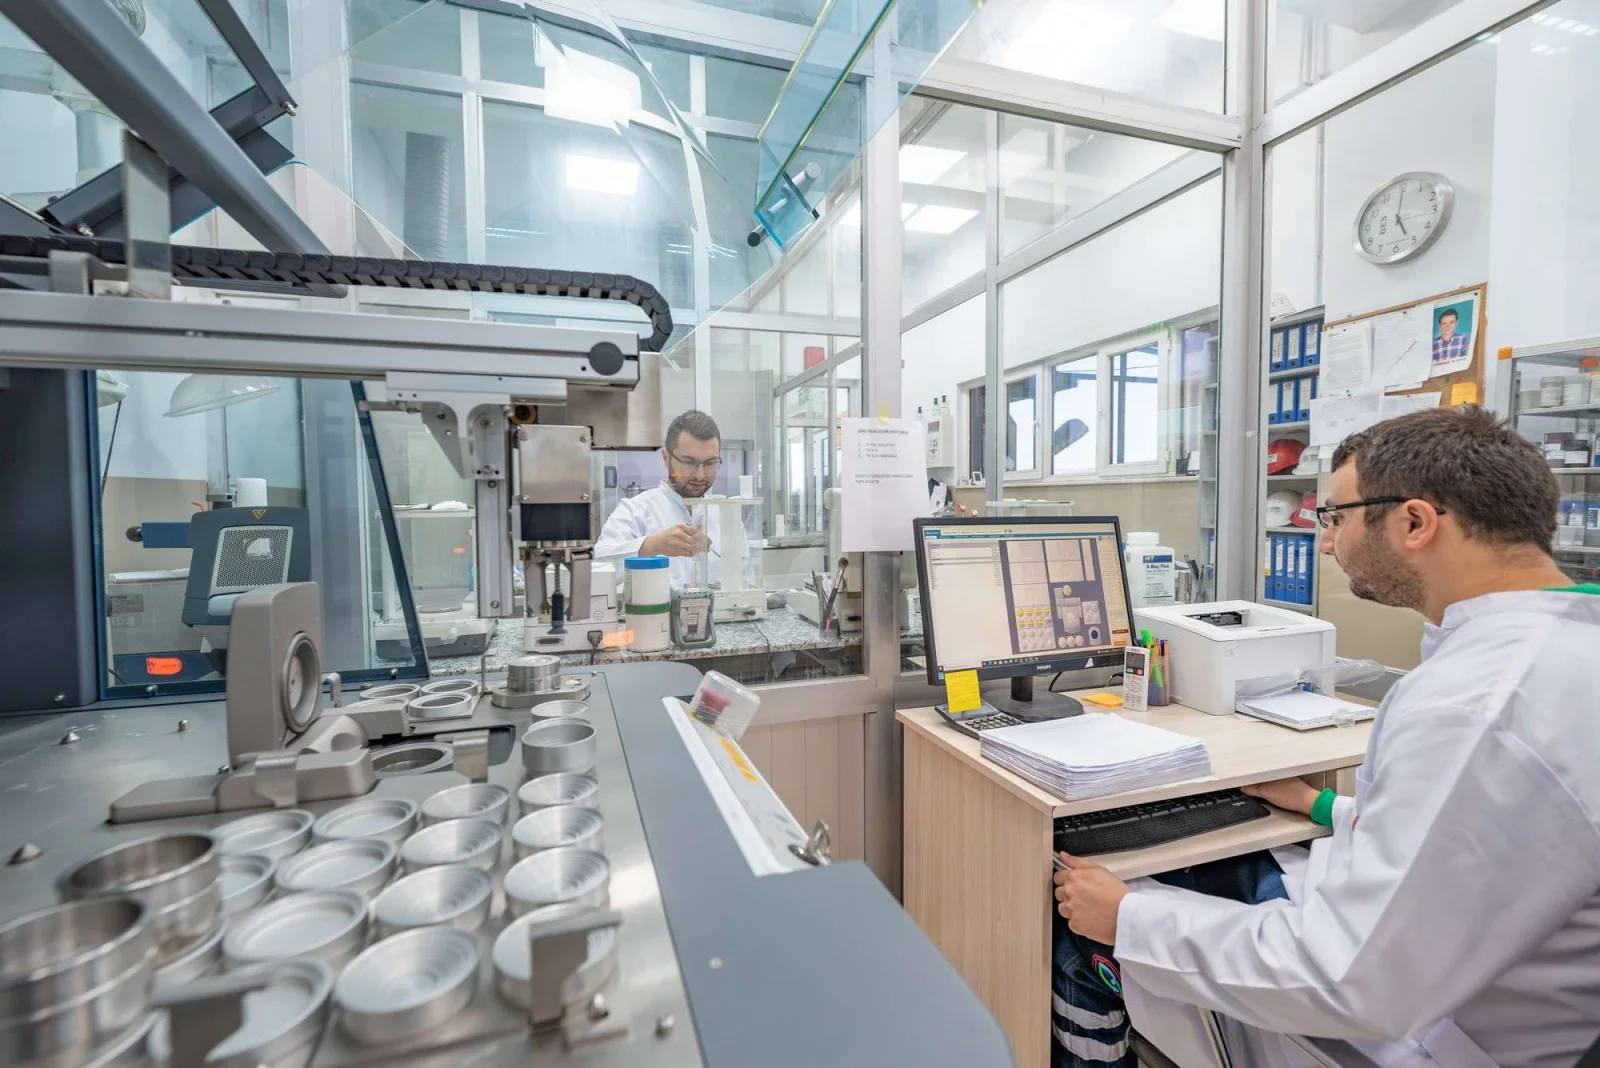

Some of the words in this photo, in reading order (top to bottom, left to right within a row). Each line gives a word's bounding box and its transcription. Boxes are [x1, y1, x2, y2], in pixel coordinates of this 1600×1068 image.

[1429, 191, 1436, 201] 2
[1370, 209, 1380, 219] 10
[1431, 205, 1438, 215] 3
[1364, 224, 1371, 234] 9
[1424, 221, 1431, 230] 4
[1367, 237, 1373, 247] 8
[1411, 236, 1417, 246] 5
[1378, 244, 1384, 254] 7
[1393, 244, 1400, 254] 6
